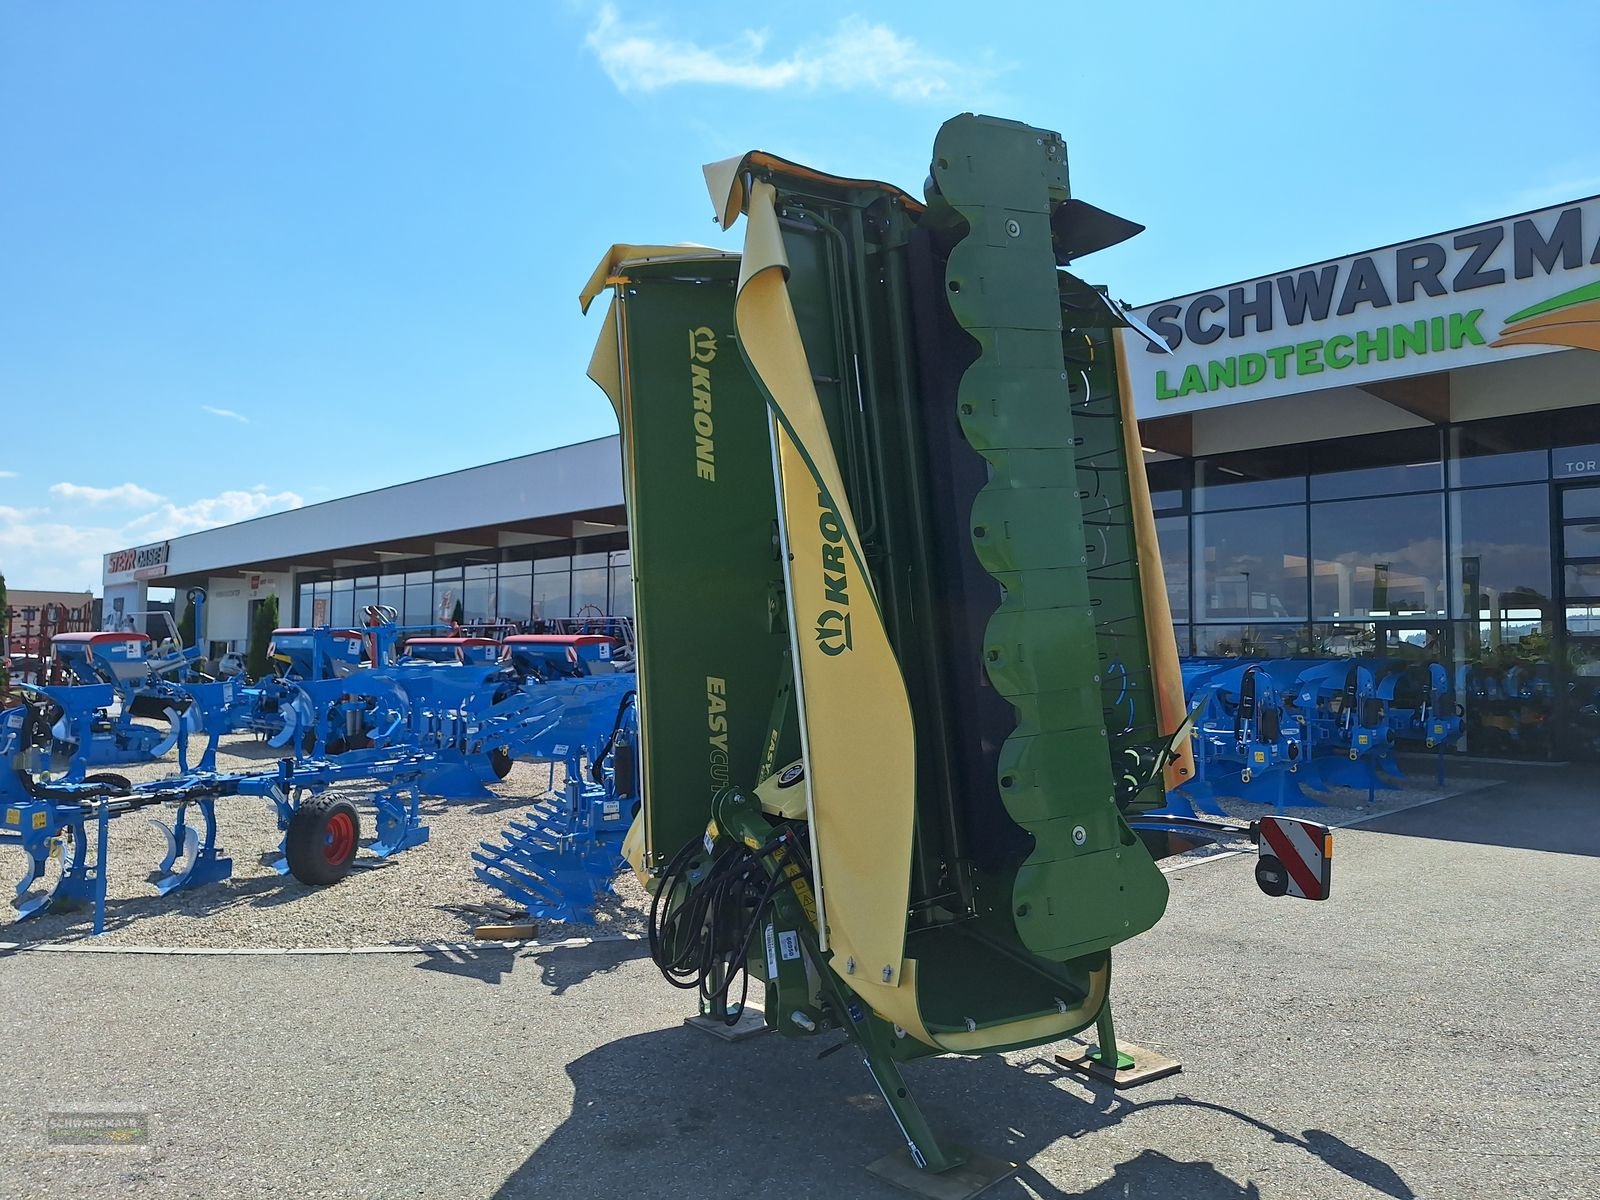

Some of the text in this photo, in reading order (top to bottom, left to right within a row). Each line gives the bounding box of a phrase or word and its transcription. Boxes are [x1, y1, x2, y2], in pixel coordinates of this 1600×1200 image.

[1146, 207, 1600, 354] SCHWARZM
[1155, 308, 1486, 400] LANDTECHNIK
[691, 363, 715, 482] KRONE
[1565, 460, 1596, 472] TOR
[108, 549, 136, 573] STEYR
